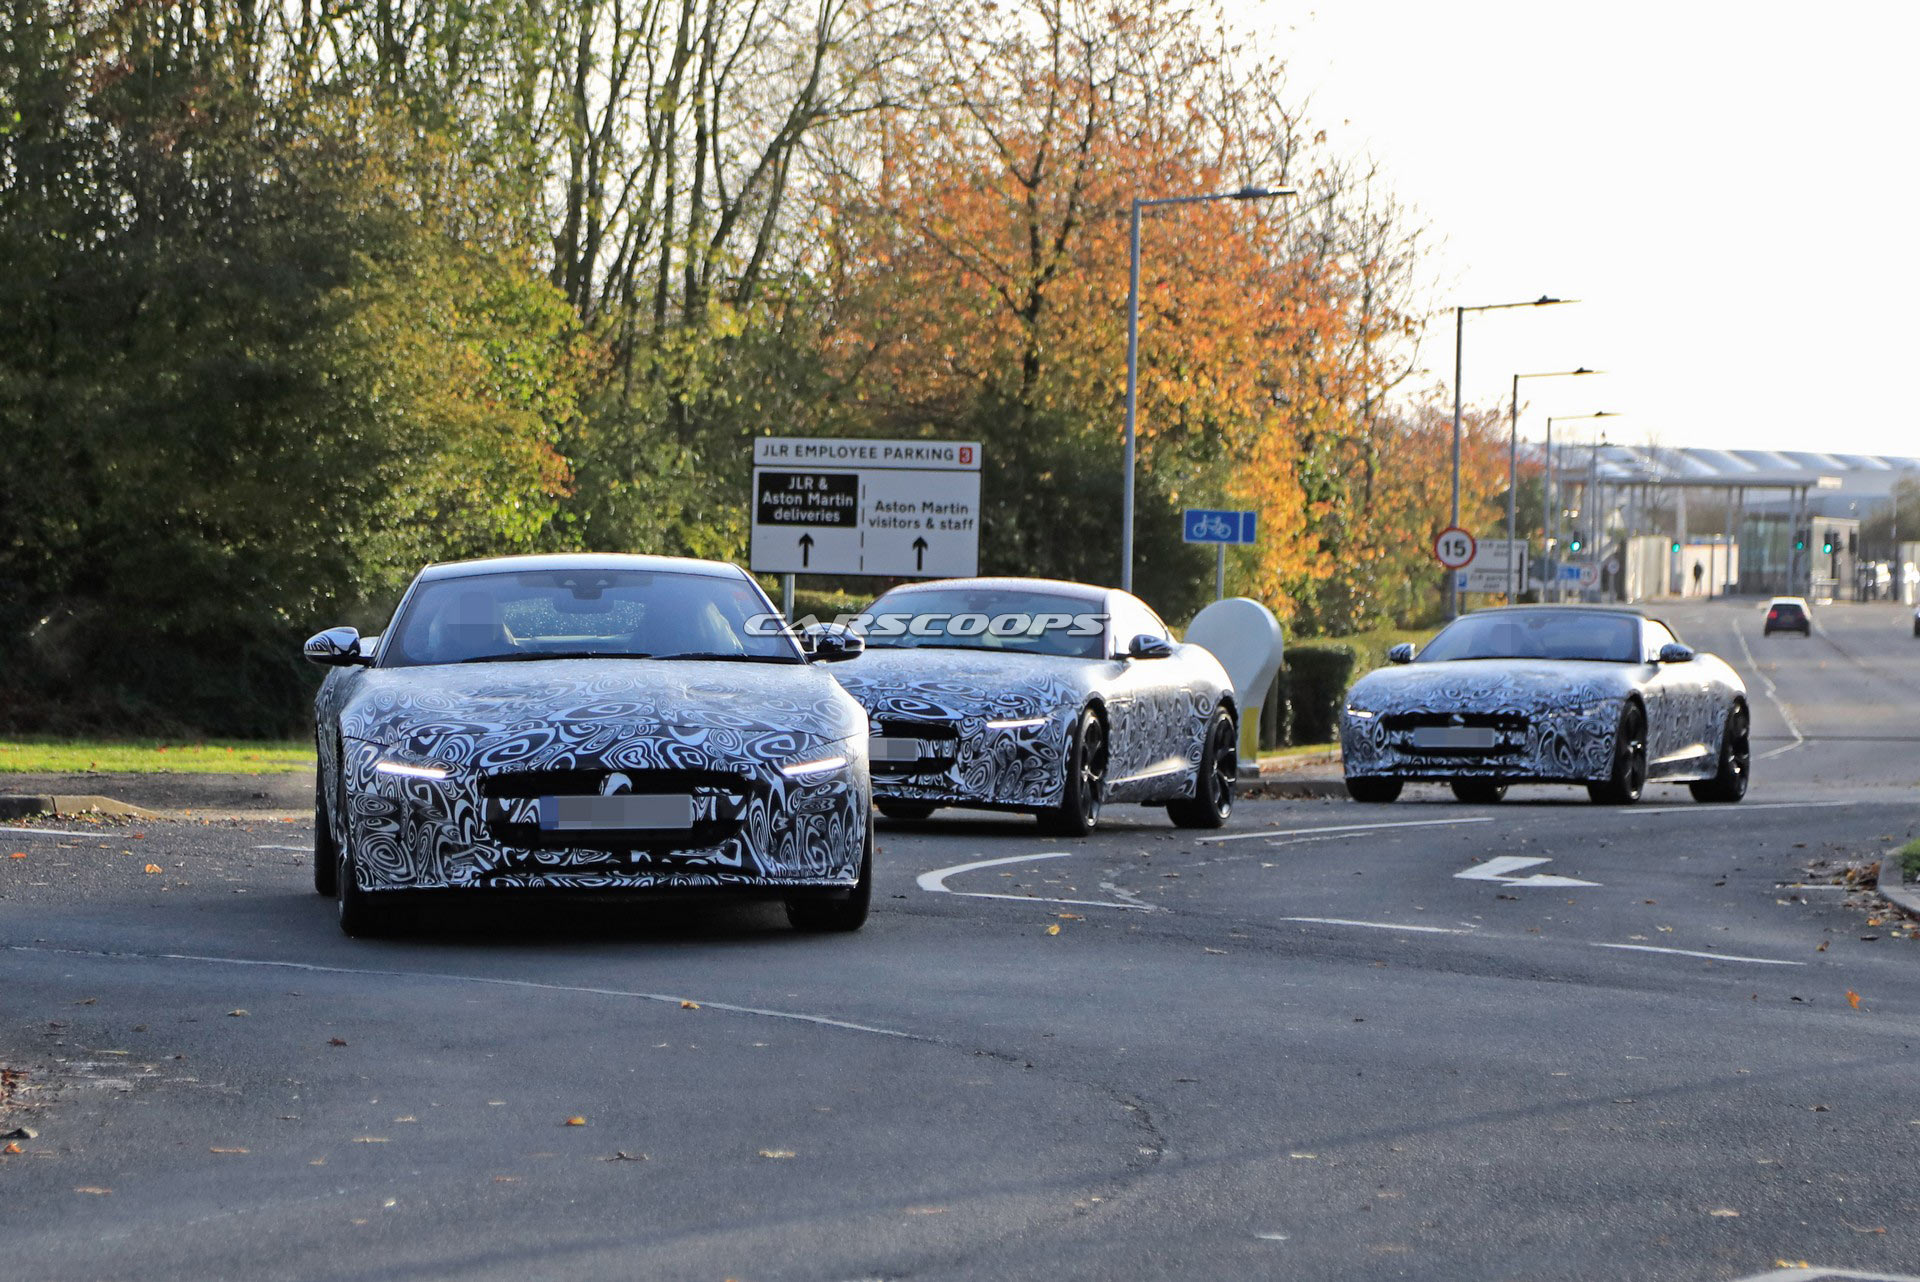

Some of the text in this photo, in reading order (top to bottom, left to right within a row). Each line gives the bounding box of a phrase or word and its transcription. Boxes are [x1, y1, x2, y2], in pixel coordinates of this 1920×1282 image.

[763, 445, 788, 457] JLR
[795, 445, 878, 459] EMPLOYEE
[884, 447, 954, 461] PARKING
[788, 476, 828, 490] JLR &
[762, 490, 854, 507] Aston Martin
[773, 507, 841, 523] deliveries
[875, 500, 969, 515] Aston Martin
[869, 516, 974, 531] visitors & staff
[1444, 540, 1466, 557] 15
